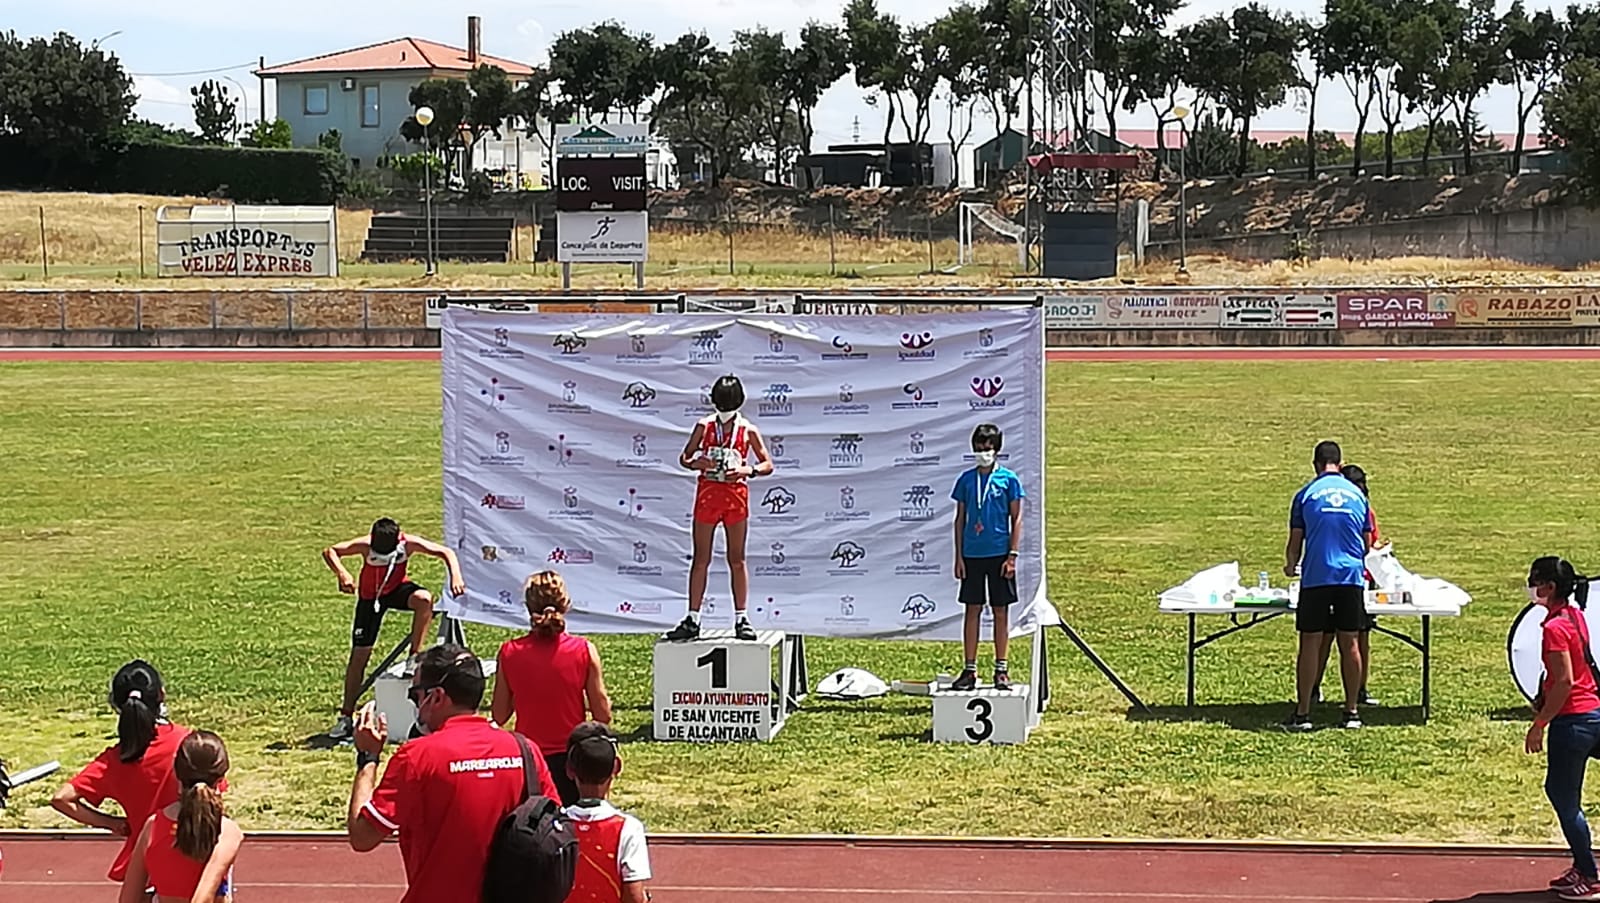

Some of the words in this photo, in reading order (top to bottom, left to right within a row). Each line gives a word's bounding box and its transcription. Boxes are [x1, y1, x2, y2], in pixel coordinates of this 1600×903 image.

[561, 176, 591, 191] LOC.
[612, 176, 646, 191] VISIT.
[181, 252, 237, 273] VELEZ
[242, 252, 313, 274] EXPRES
[792, 303, 873, 315] UERTITA
[1348, 298, 1423, 311] SPAR
[1487, 298, 1572, 310] RABAZO
[697, 647, 727, 689] 1
[672, 692, 702, 705] EXCMO
[703, 692, 769, 706] AYUNTAMIENTO
[663, 709, 679, 722] DE
[681, 709, 707, 722] SAN
[709, 710, 761, 723] VICENTE
[965, 697, 994, 742] 3
[668, 725, 685, 738] DE
[687, 725, 758, 739] ALCANTARA
